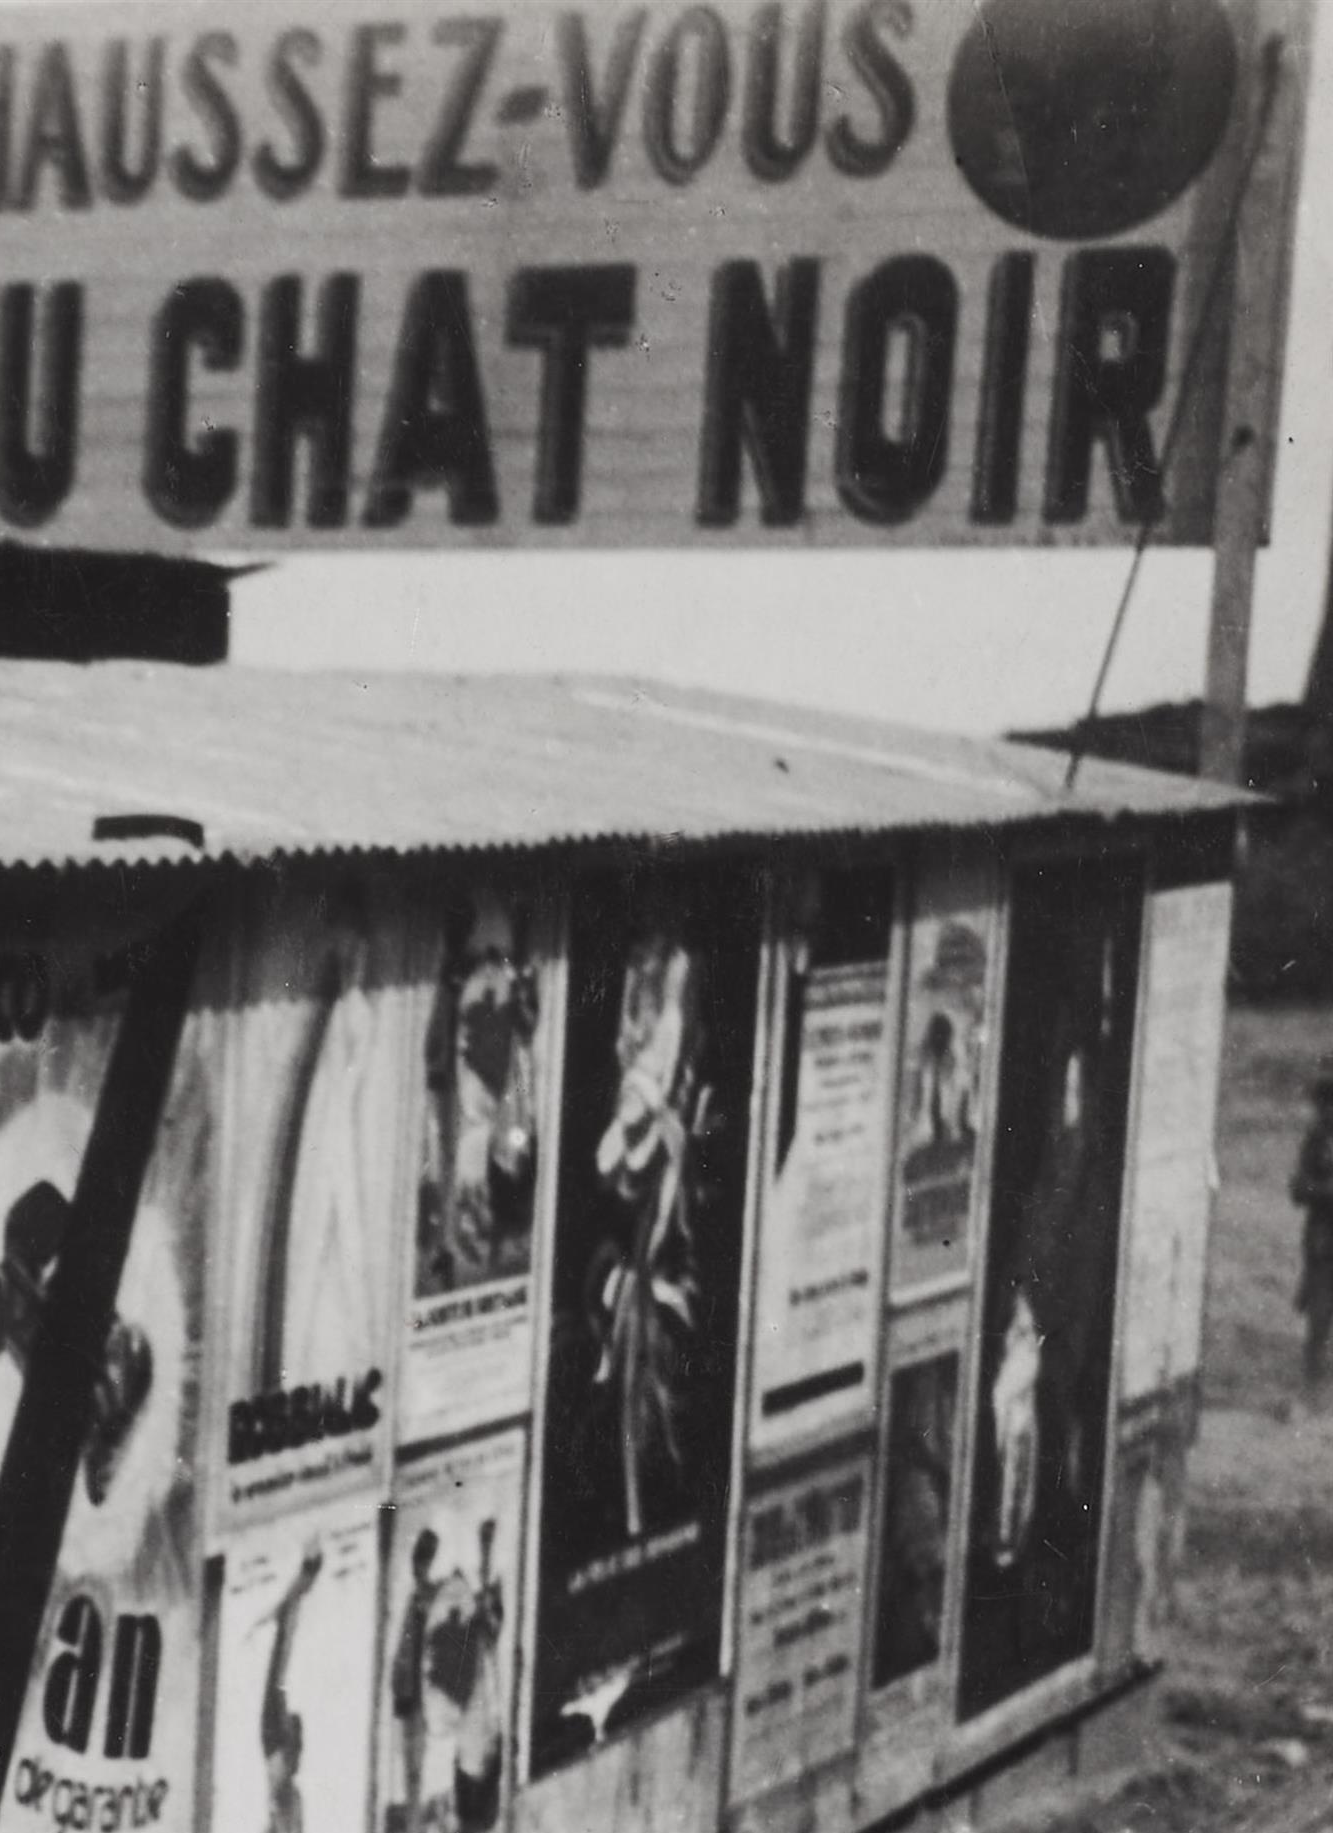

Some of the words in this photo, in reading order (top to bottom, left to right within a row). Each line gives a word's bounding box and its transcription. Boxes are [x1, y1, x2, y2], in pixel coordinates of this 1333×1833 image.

[139, 264, 636, 530] CHAT
[696, 246, 1181, 528] NOIR
[43, 1593, 163, 1760] an
